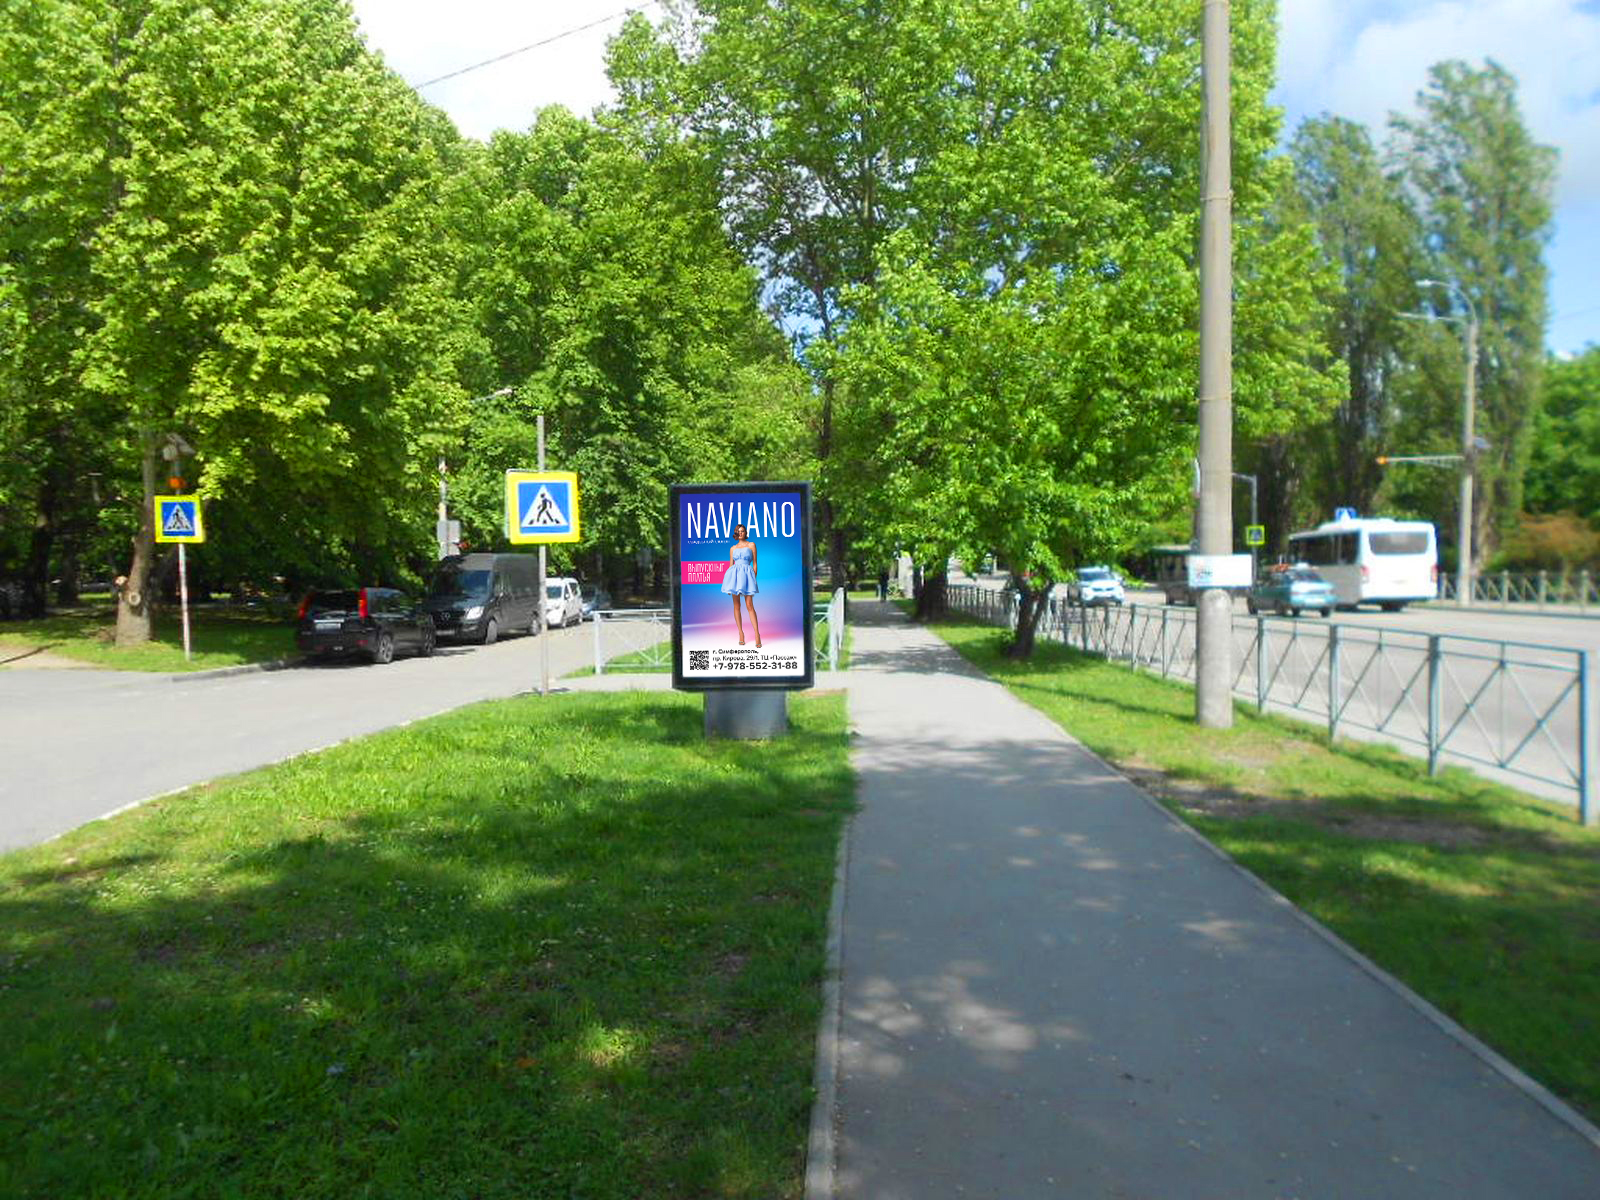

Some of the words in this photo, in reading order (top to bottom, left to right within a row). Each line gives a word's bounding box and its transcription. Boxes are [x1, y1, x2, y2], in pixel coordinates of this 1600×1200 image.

[687, 501, 795, 539] NAVIANO
[687, 572, 711, 582] ПЛАТЬЯ
[712, 661, 798, 670] +7-978-552-31-88
